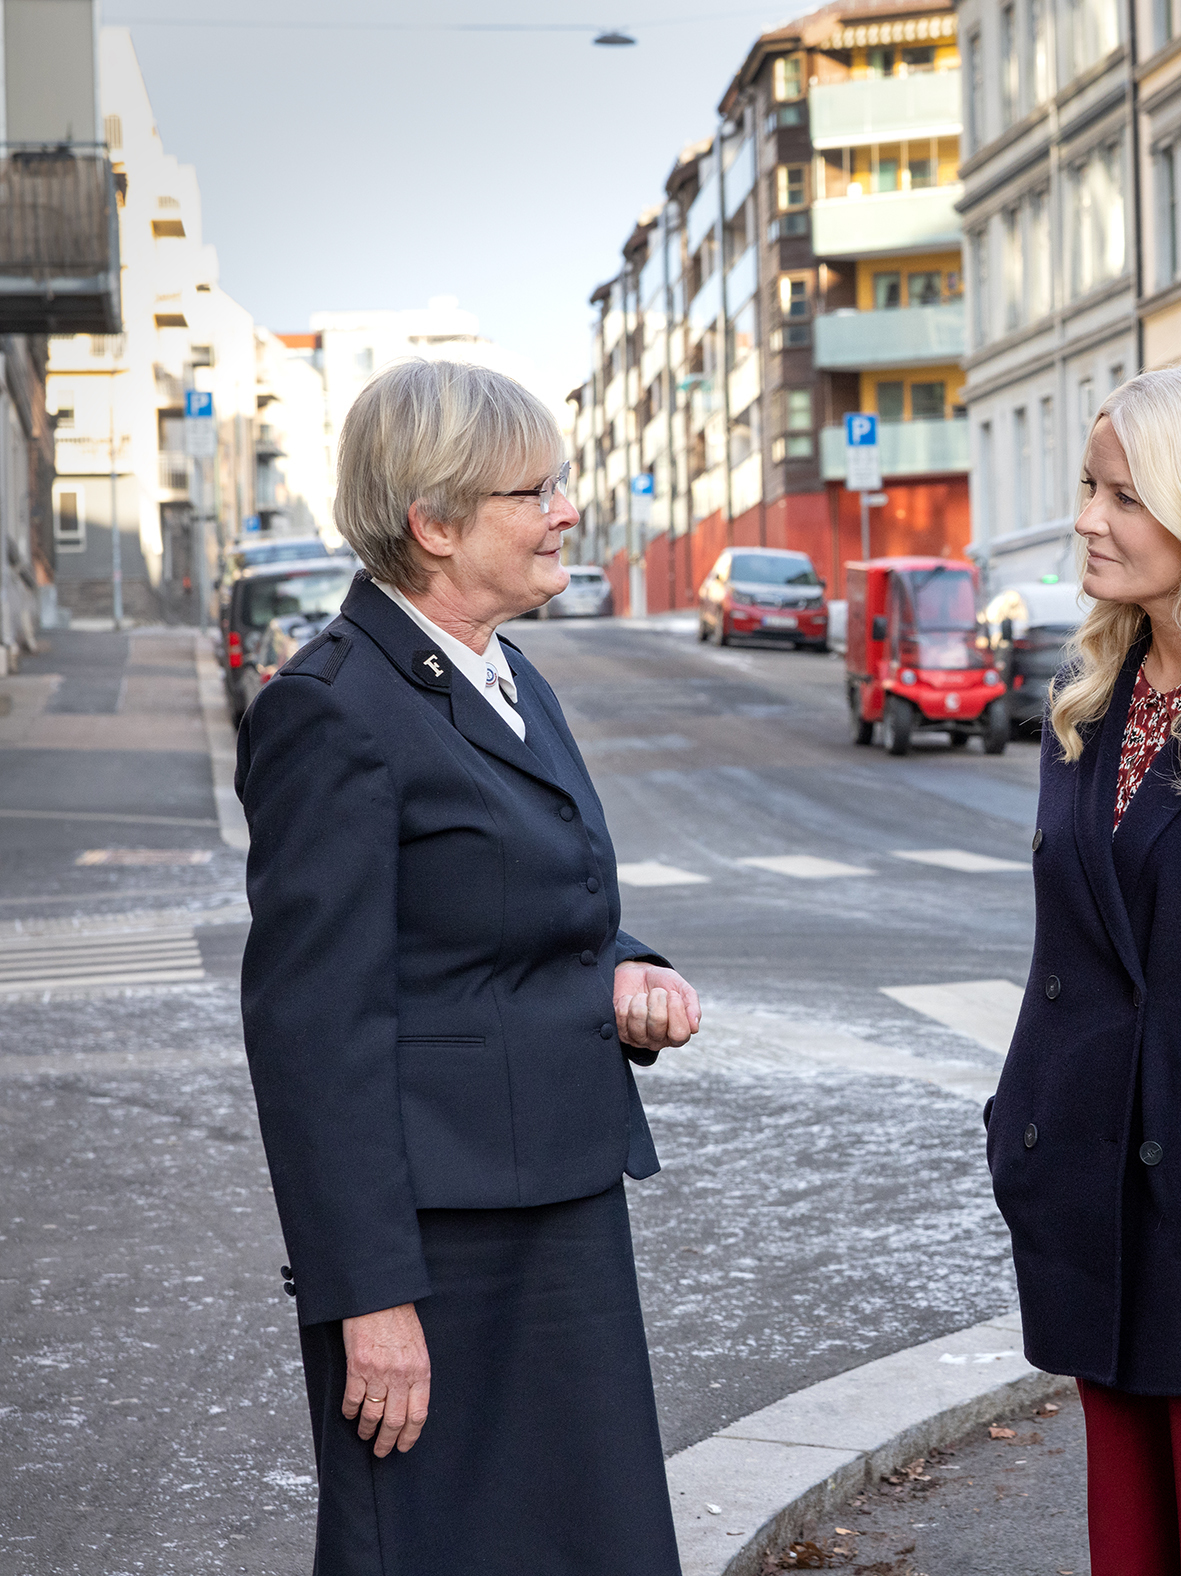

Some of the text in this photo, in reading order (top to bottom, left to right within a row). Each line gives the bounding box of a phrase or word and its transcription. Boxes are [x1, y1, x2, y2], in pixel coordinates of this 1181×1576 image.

[190, 391, 210, 416] P
[852, 416, 872, 444] P
[423, 654, 444, 677] F
